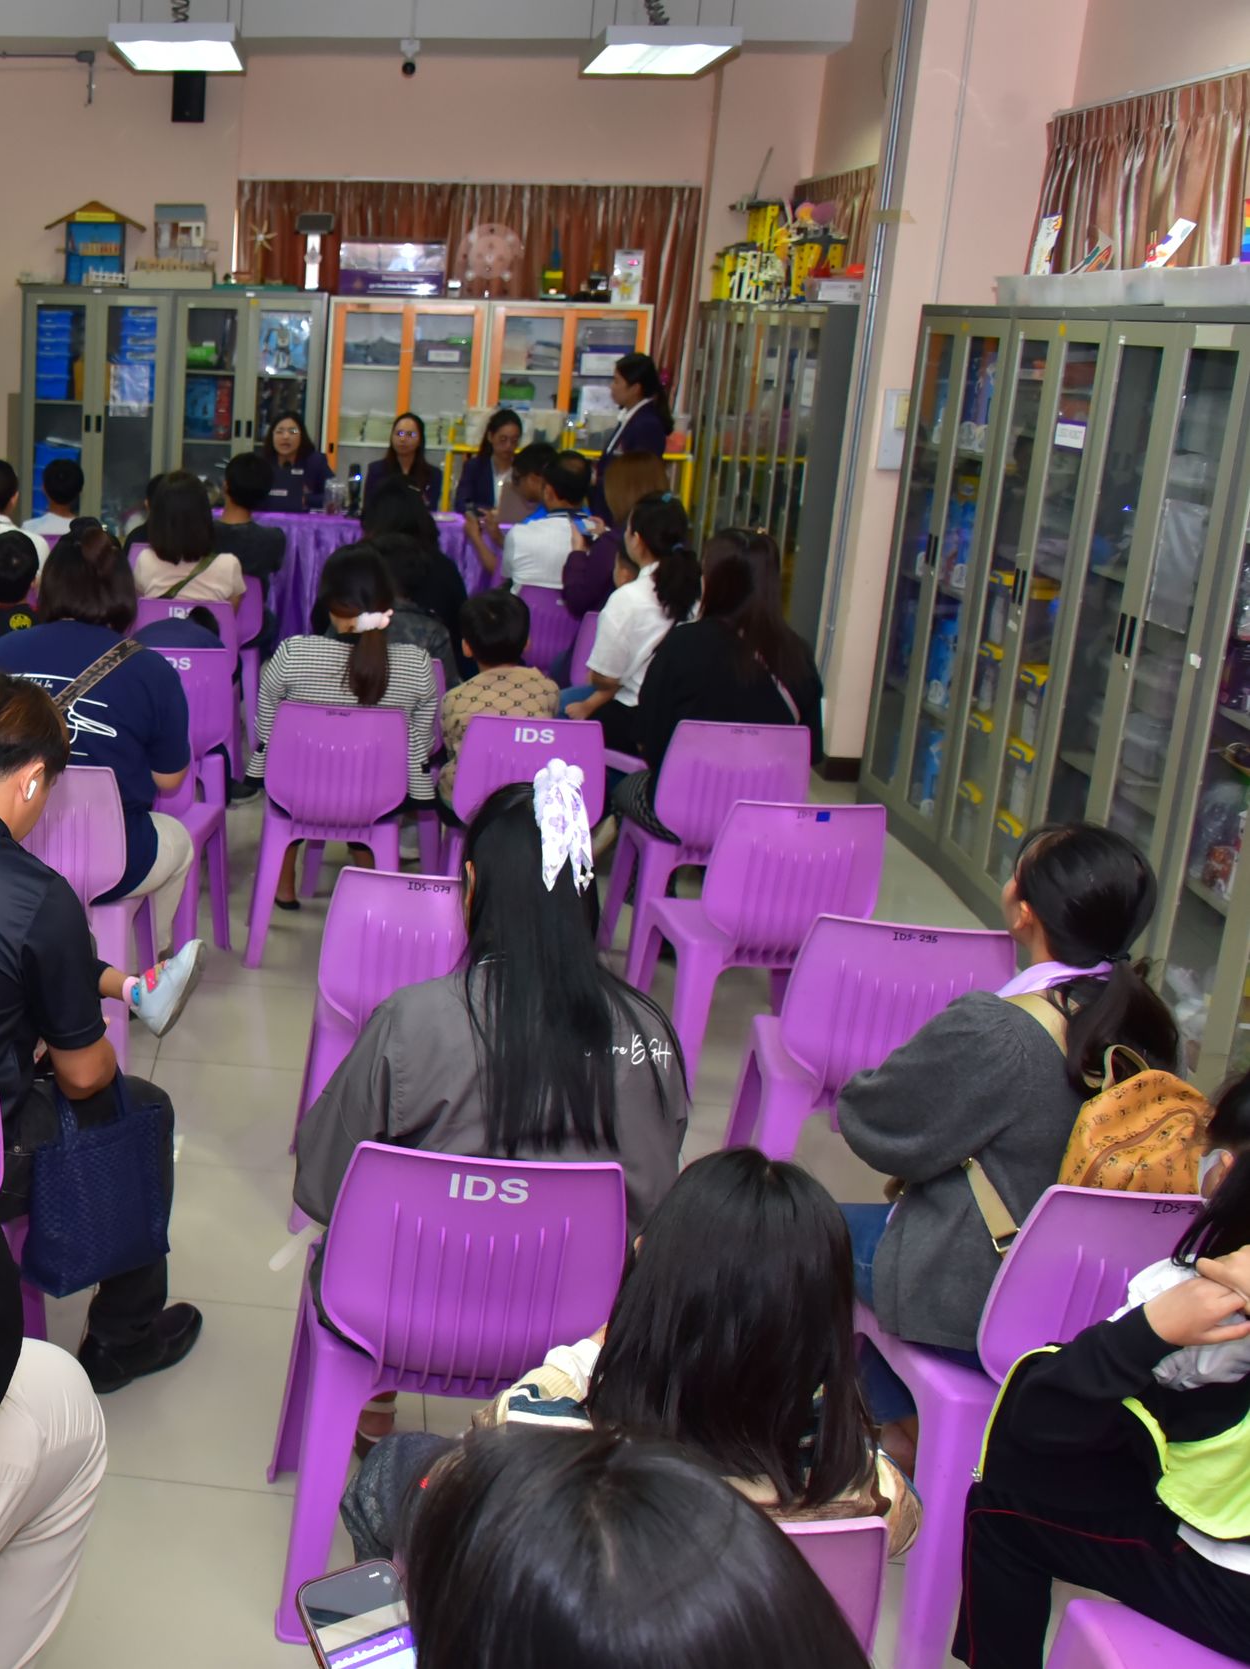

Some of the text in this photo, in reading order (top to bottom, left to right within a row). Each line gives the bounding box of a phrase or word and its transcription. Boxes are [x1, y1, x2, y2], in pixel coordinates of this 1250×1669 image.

[514, 727, 555, 745] IDS
[407, 881, 452, 894] IDS-079
[448, 1172, 530, 1205] IDS
